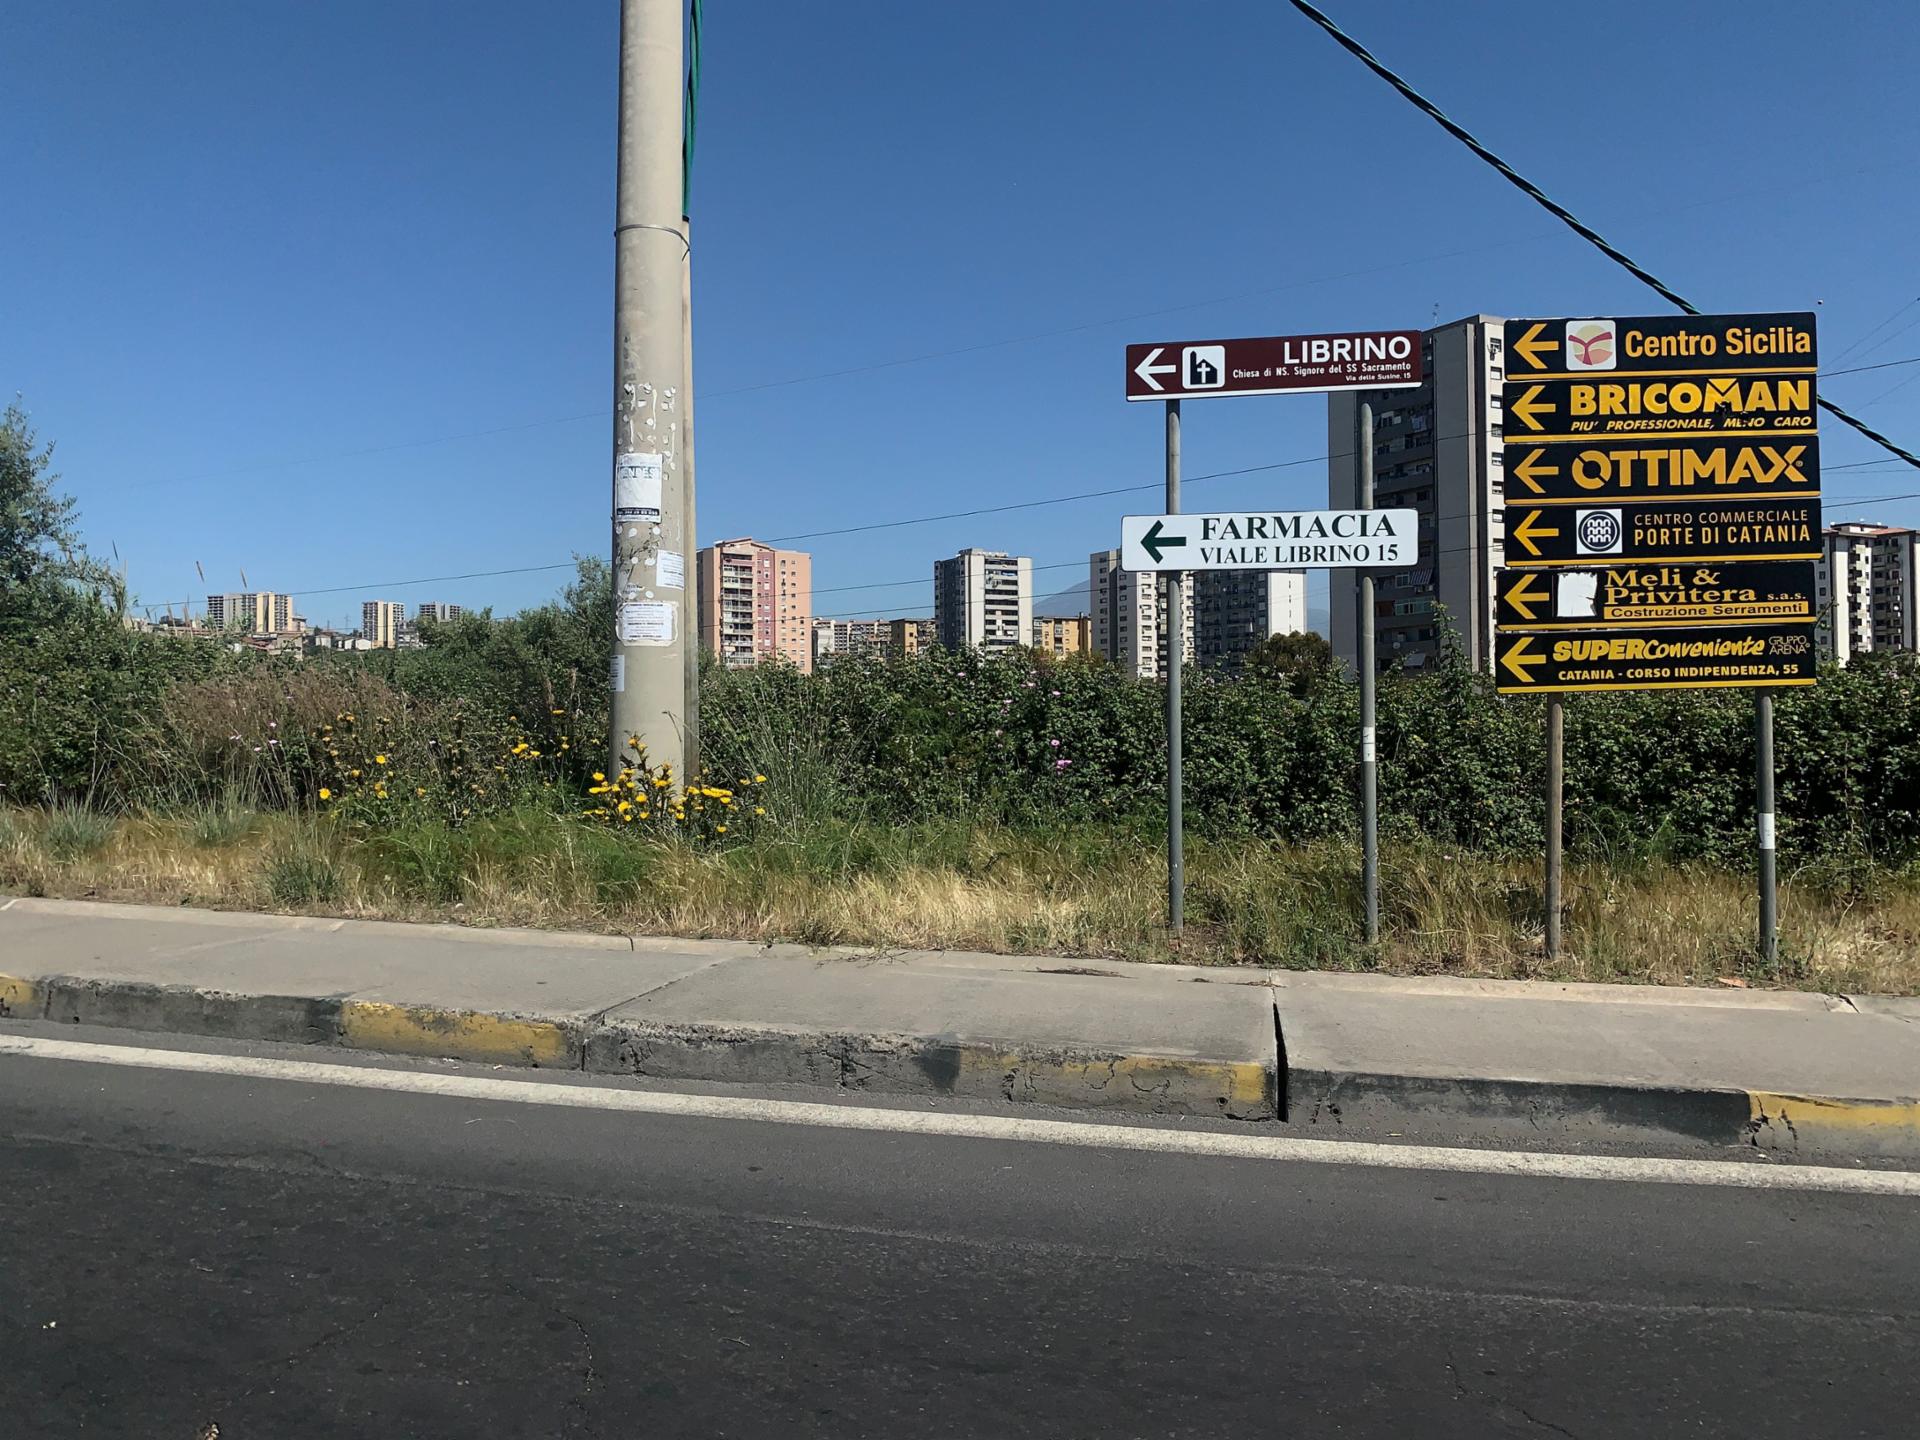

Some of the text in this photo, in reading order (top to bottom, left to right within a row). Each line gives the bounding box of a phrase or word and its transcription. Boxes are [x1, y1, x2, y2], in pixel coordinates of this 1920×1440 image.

[1283, 335, 1412, 365] LIBRINO
[1625, 326, 1811, 358] Centro Sicilia
[1232, 361, 1412, 379] Chiesa di NS. Signore del SS Sacramento
[1570, 378, 1810, 416] BRICOMAN
[1606, 418, 1715, 431] PROFESSIONALE,
[1773, 415, 1812, 427] CARO
[1571, 445, 1809, 490] OTTIMAX
[1200, 513, 1398, 541] FARMACIA
[1634, 509, 1809, 526] CENTRO COMMERCIALE
[1634, 524, 1811, 546] PORTE DI CATANIA
[1200, 543, 1399, 564] VIALE LIBRINO 15
[1605, 568, 1721, 588] Meli &
[1603, 585, 1807, 605] Privitera s.a.s.
[1611, 602, 1803, 618] Costruzione Serramenti
[1768, 635, 1807, 645] GRUPPO
[1768, 644, 1807, 655] ARENA
[1557, 668, 1615, 681] CATANIA
[1626, 667, 1672, 679] CORSO
[1674, 664, 1781, 678] INDIPENDENZA,
[1783, 664, 1799, 675] 55
